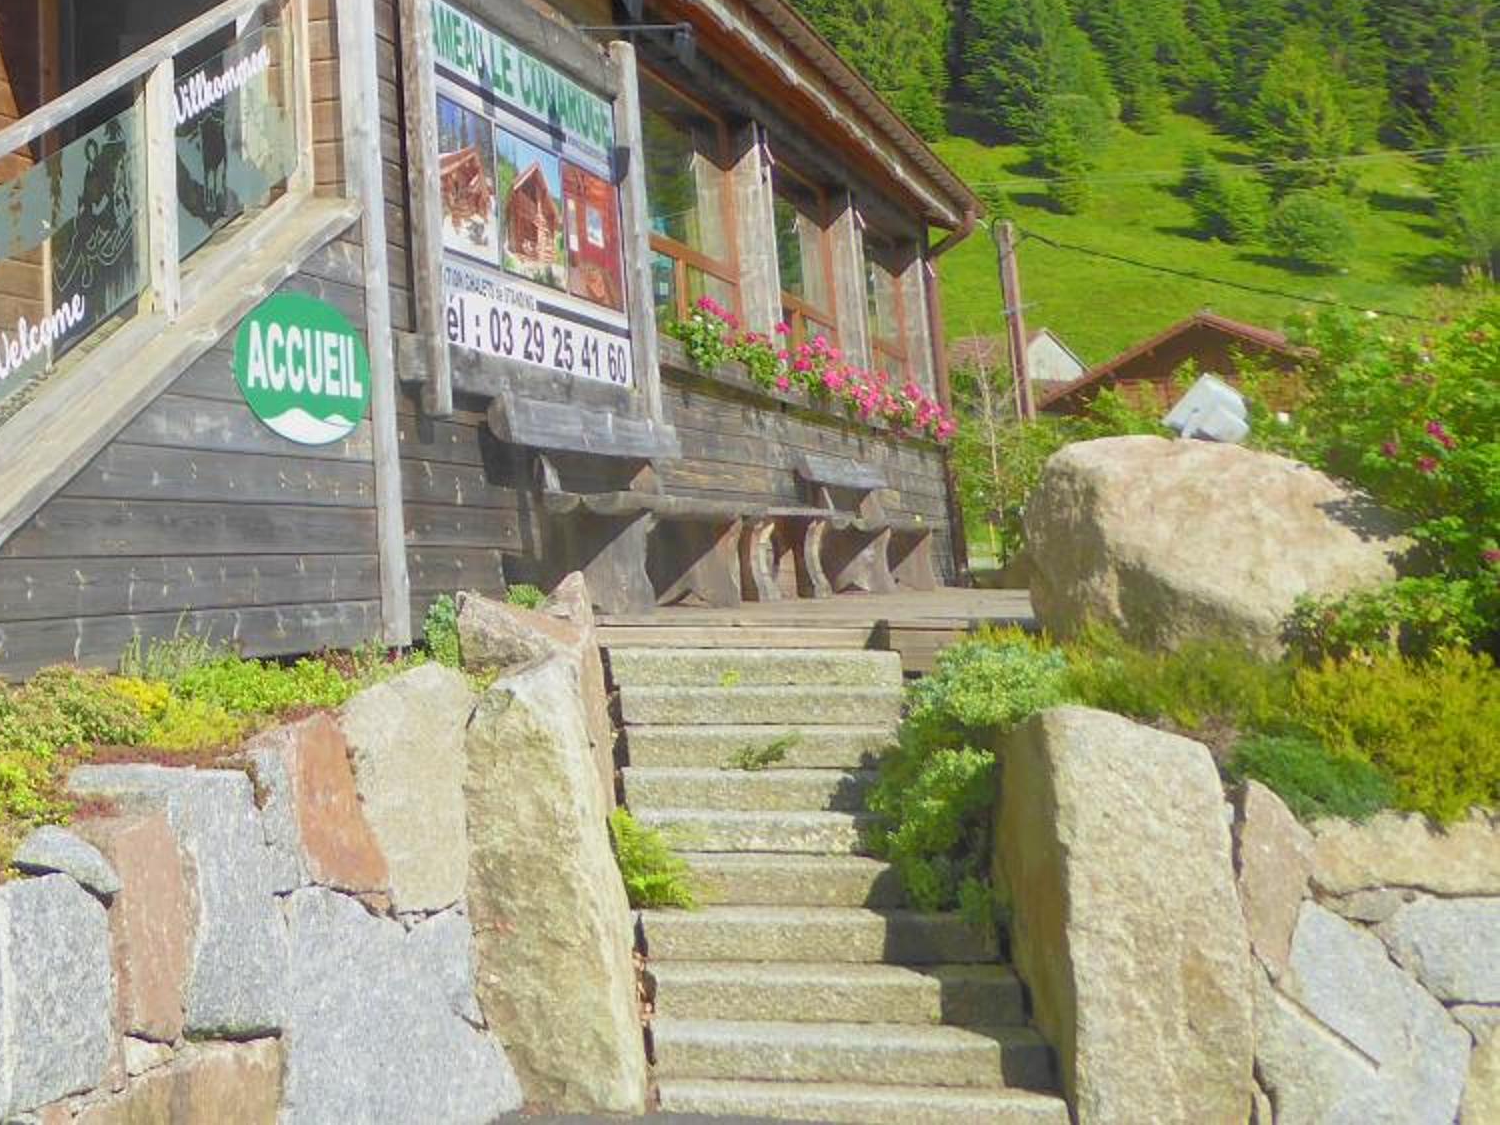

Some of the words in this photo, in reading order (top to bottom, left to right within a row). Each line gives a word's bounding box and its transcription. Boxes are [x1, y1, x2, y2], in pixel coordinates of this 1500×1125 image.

[247, 320, 364, 400] ACCUEIL
[489, 306, 514, 356] 03
[521, 316, 545, 364] 29
[552, 325, 575, 372] 25
[581, 333, 600, 377] 41
[607, 342, 628, 384] 60
